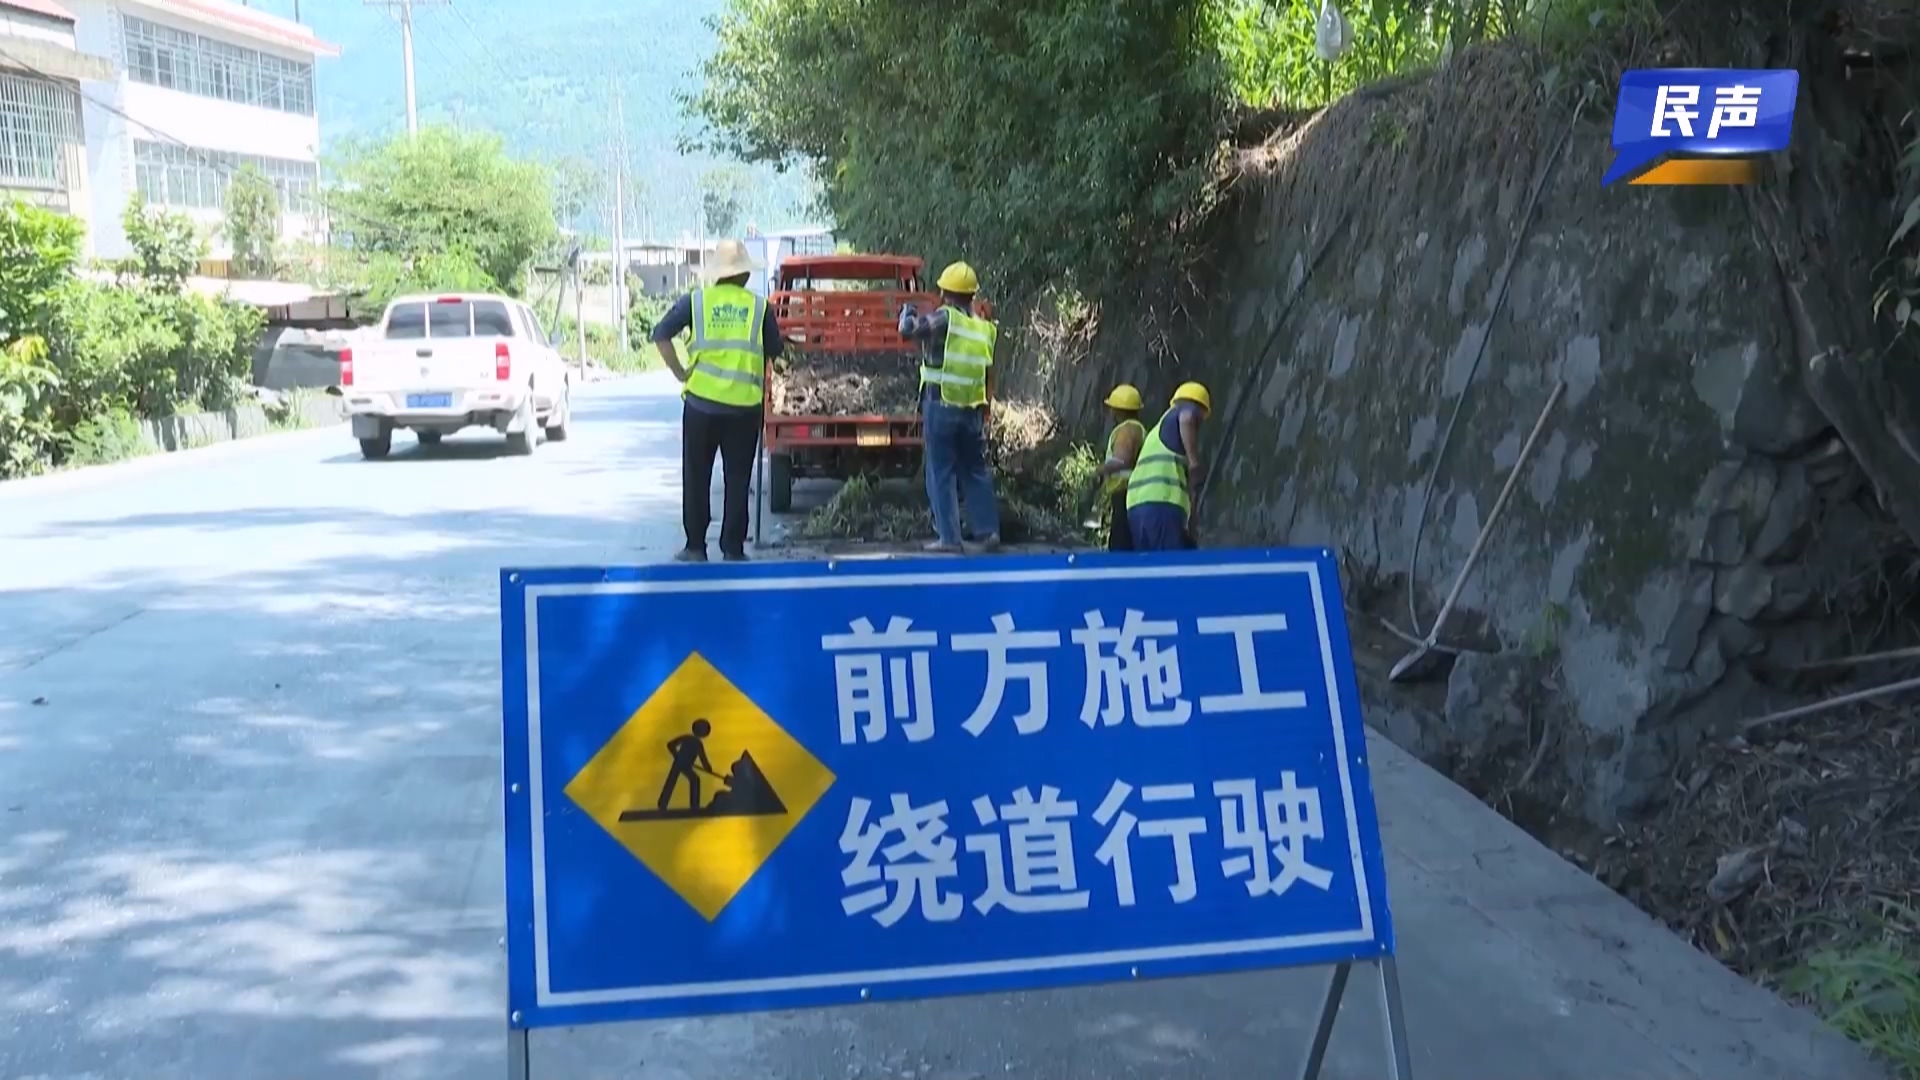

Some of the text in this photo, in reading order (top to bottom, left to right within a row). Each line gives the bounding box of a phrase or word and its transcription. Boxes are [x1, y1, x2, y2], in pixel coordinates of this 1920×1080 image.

[821, 608, 1307, 744] 前方施工
[838, 770, 1334, 928] 绕道行驶
